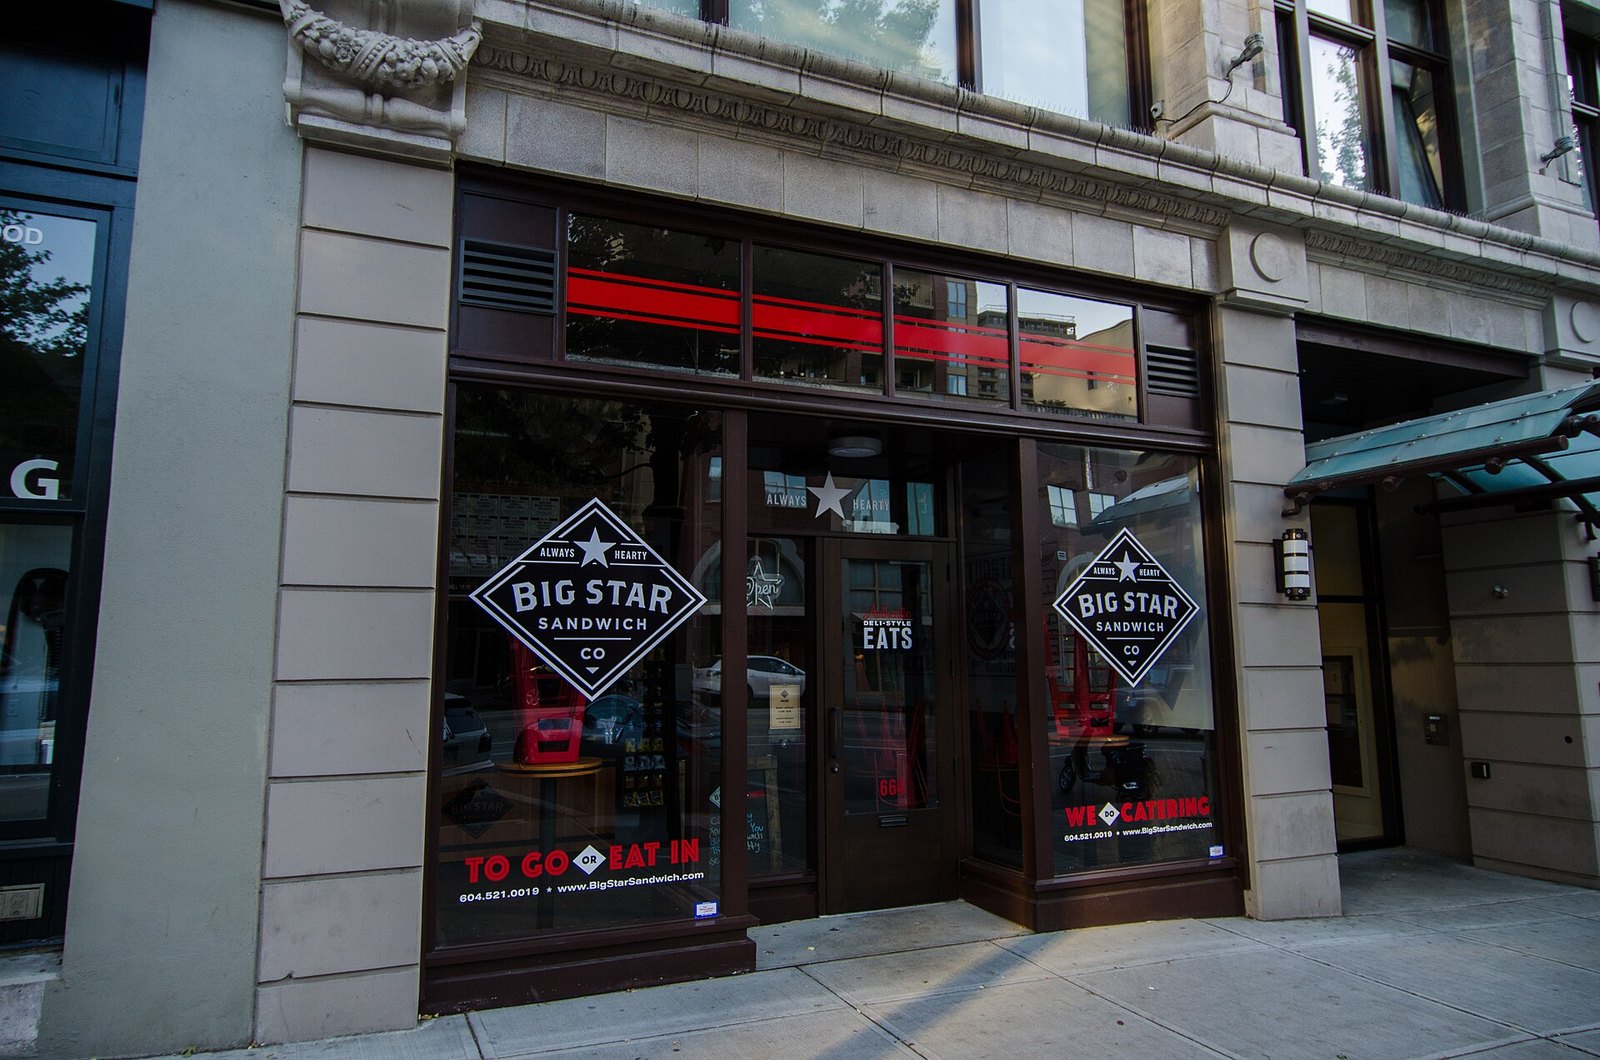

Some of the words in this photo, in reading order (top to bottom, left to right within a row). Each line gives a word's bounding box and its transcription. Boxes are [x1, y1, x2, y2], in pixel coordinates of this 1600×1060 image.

[766, 492, 807, 508] ALWAYS
[852, 498, 890, 512] HEARTY
[539, 546, 576, 559] ALWAYS
[614, 549, 648, 562] HEARTY
[1093, 566, 1116, 576] ALWAYS
[1139, 568, 1161, 578] HEARTY
[511, 579, 576, 613] BIG
[586, 579, 673, 615] STAR
[1077, 591, 1118, 619] BIG
[1123, 591, 1179, 620] STAR
[537, 617, 648, 631] SANDWICH
[1096, 621, 1165, 632] SANDWICH
[863, 627, 913, 650] EATS
[580, 647, 606, 660] CO
[1123, 645, 1140, 656] CO
[1065, 804, 1097, 828] WE
[1104, 810, 1115, 818] DO
[1120, 796, 1211, 823] CATERING
[1064, 830, 1113, 842] 604.521.0019
[1122, 821, 1213, 837] www.BigStarSandwich.com
[464, 855, 510, 884] TO
[521, 849, 570, 877] GO
[581, 855, 598, 865] OR
[609, 841, 661, 871] EAT
[670, 838, 700, 865] IN
[459, 886, 541, 903] 604.521.0019
[557, 871, 705, 893] www.BigStarSandwich.com
